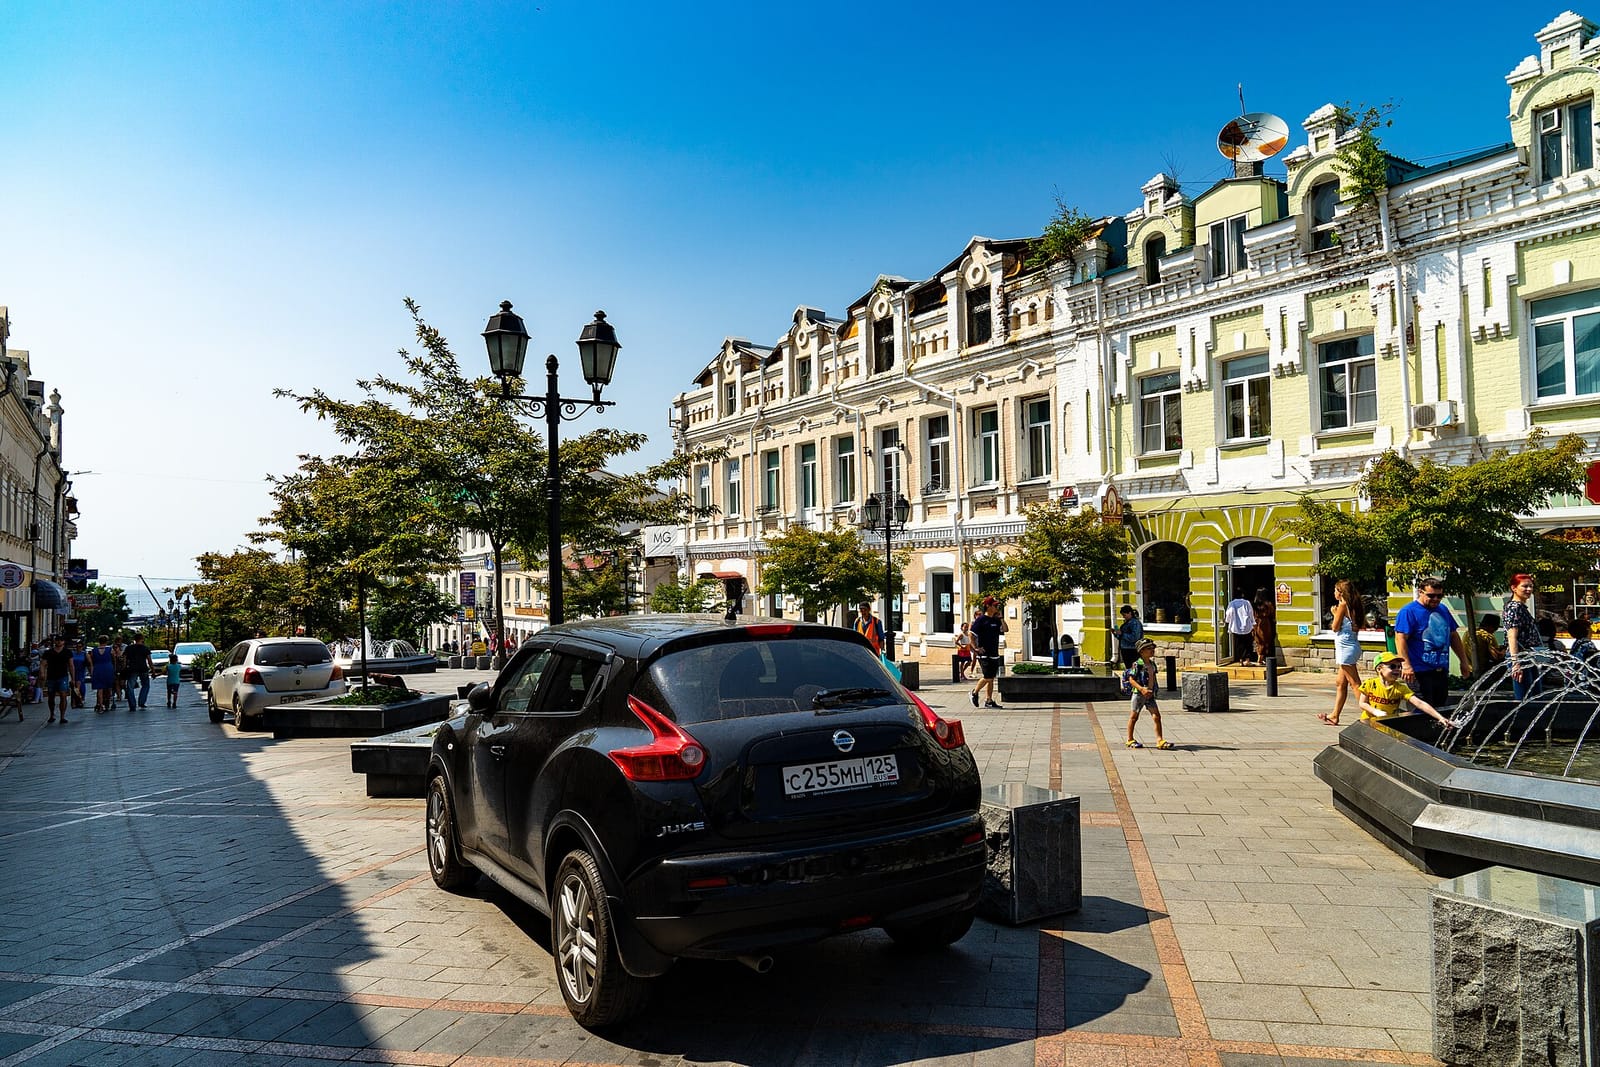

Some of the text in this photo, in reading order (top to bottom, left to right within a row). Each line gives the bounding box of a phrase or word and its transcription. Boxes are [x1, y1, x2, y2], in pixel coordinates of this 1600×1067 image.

[653, 531, 672, 543] MG
[866, 757, 894, 775] 125
[656, 821, 705, 838] JUKE
